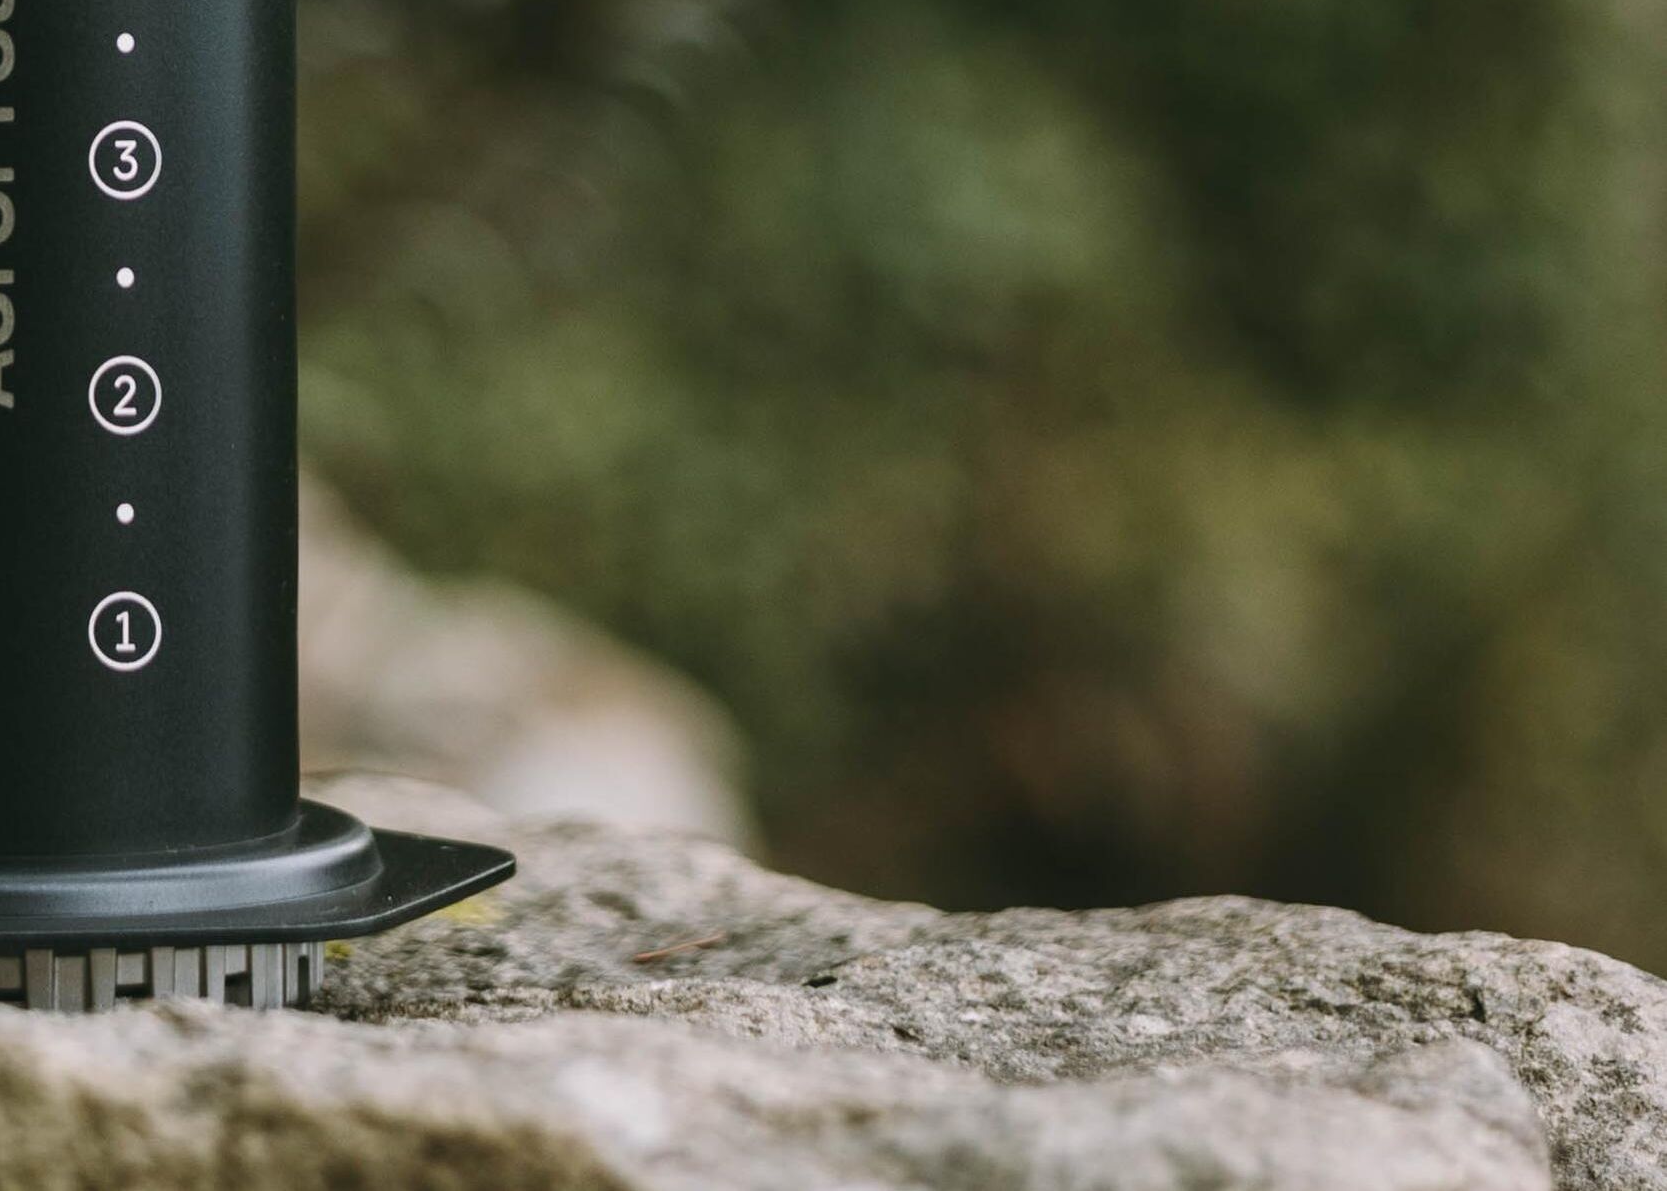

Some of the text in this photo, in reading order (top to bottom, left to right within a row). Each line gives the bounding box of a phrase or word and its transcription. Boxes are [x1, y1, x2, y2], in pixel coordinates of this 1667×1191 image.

[112, 139, 139, 182] 3
[113, 374, 138, 417] 2
[115, 610, 137, 653] 1
